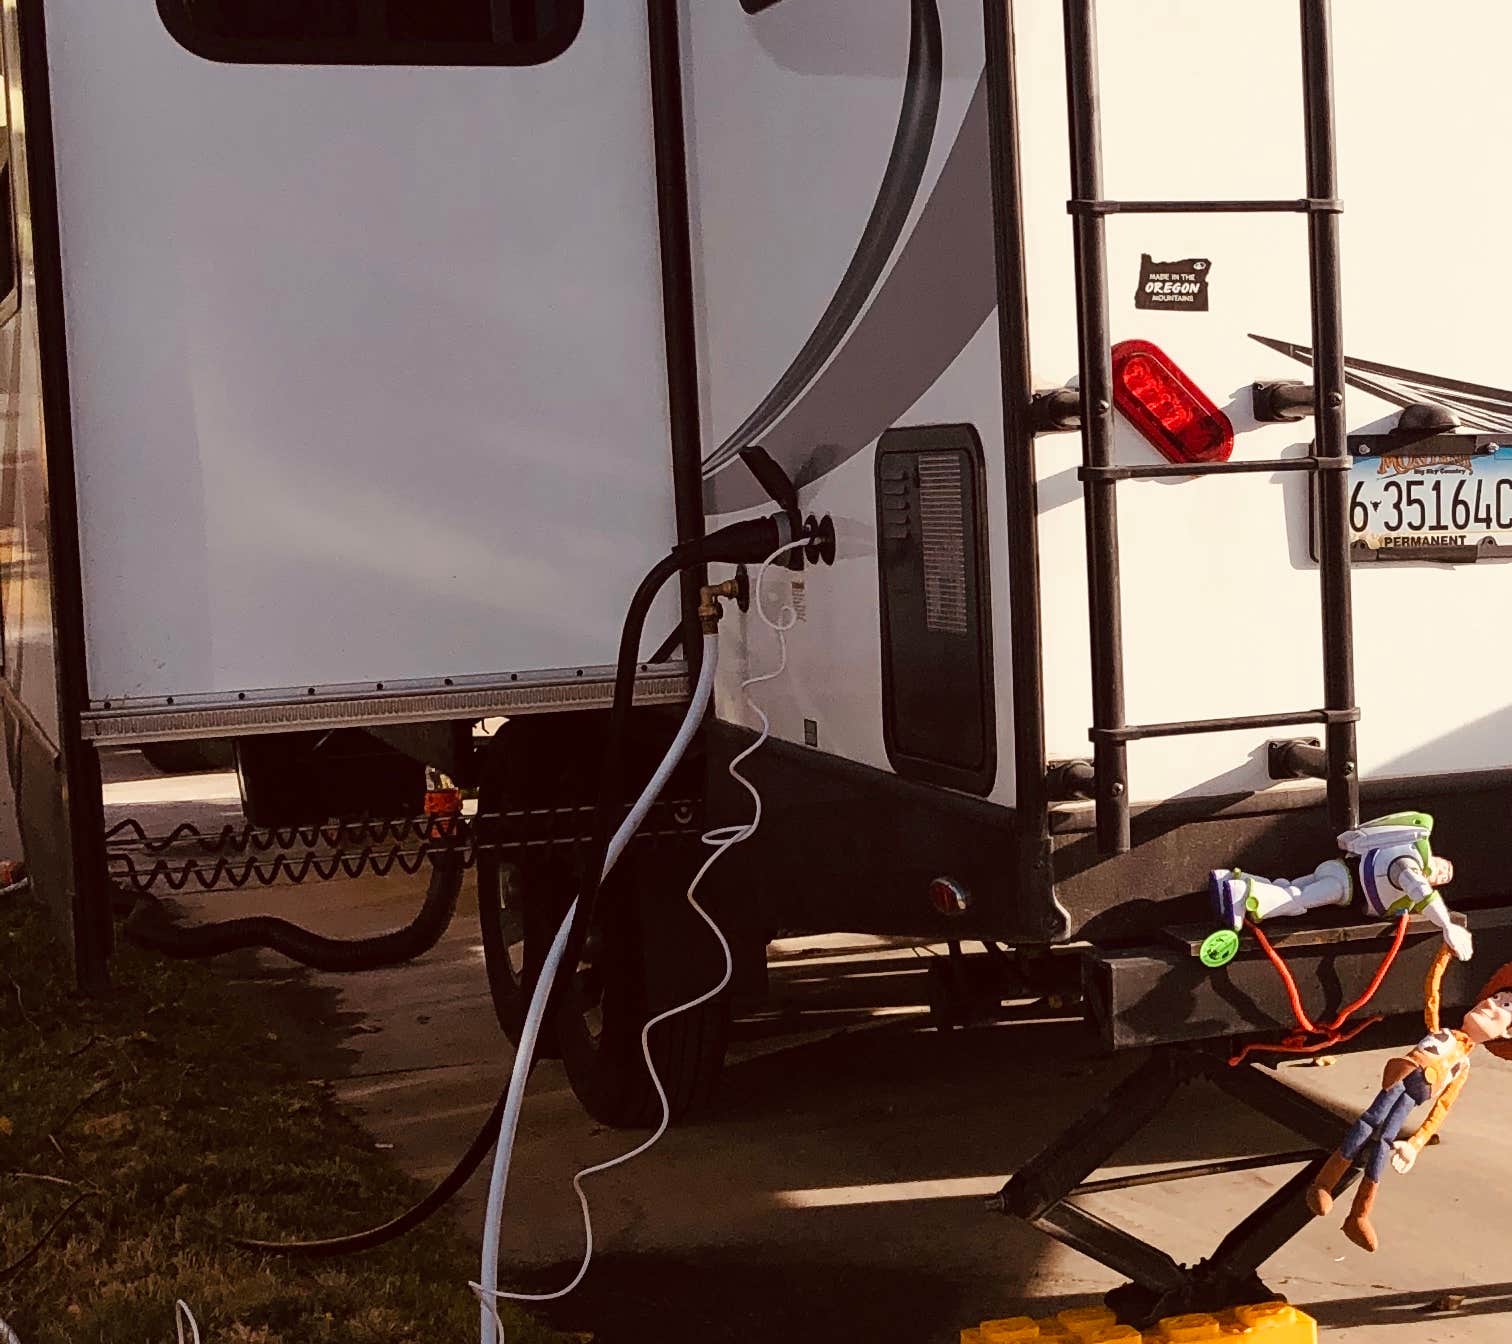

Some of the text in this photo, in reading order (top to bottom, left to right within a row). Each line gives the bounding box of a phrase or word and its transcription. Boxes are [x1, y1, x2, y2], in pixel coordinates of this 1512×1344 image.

[1180, 273, 1195, 281] THE
[1144, 281, 1200, 294] OREGON
[1152, 294, 1194, 302] MOUNTAINS
[1384, 535, 1467, 548] PERMANENT
